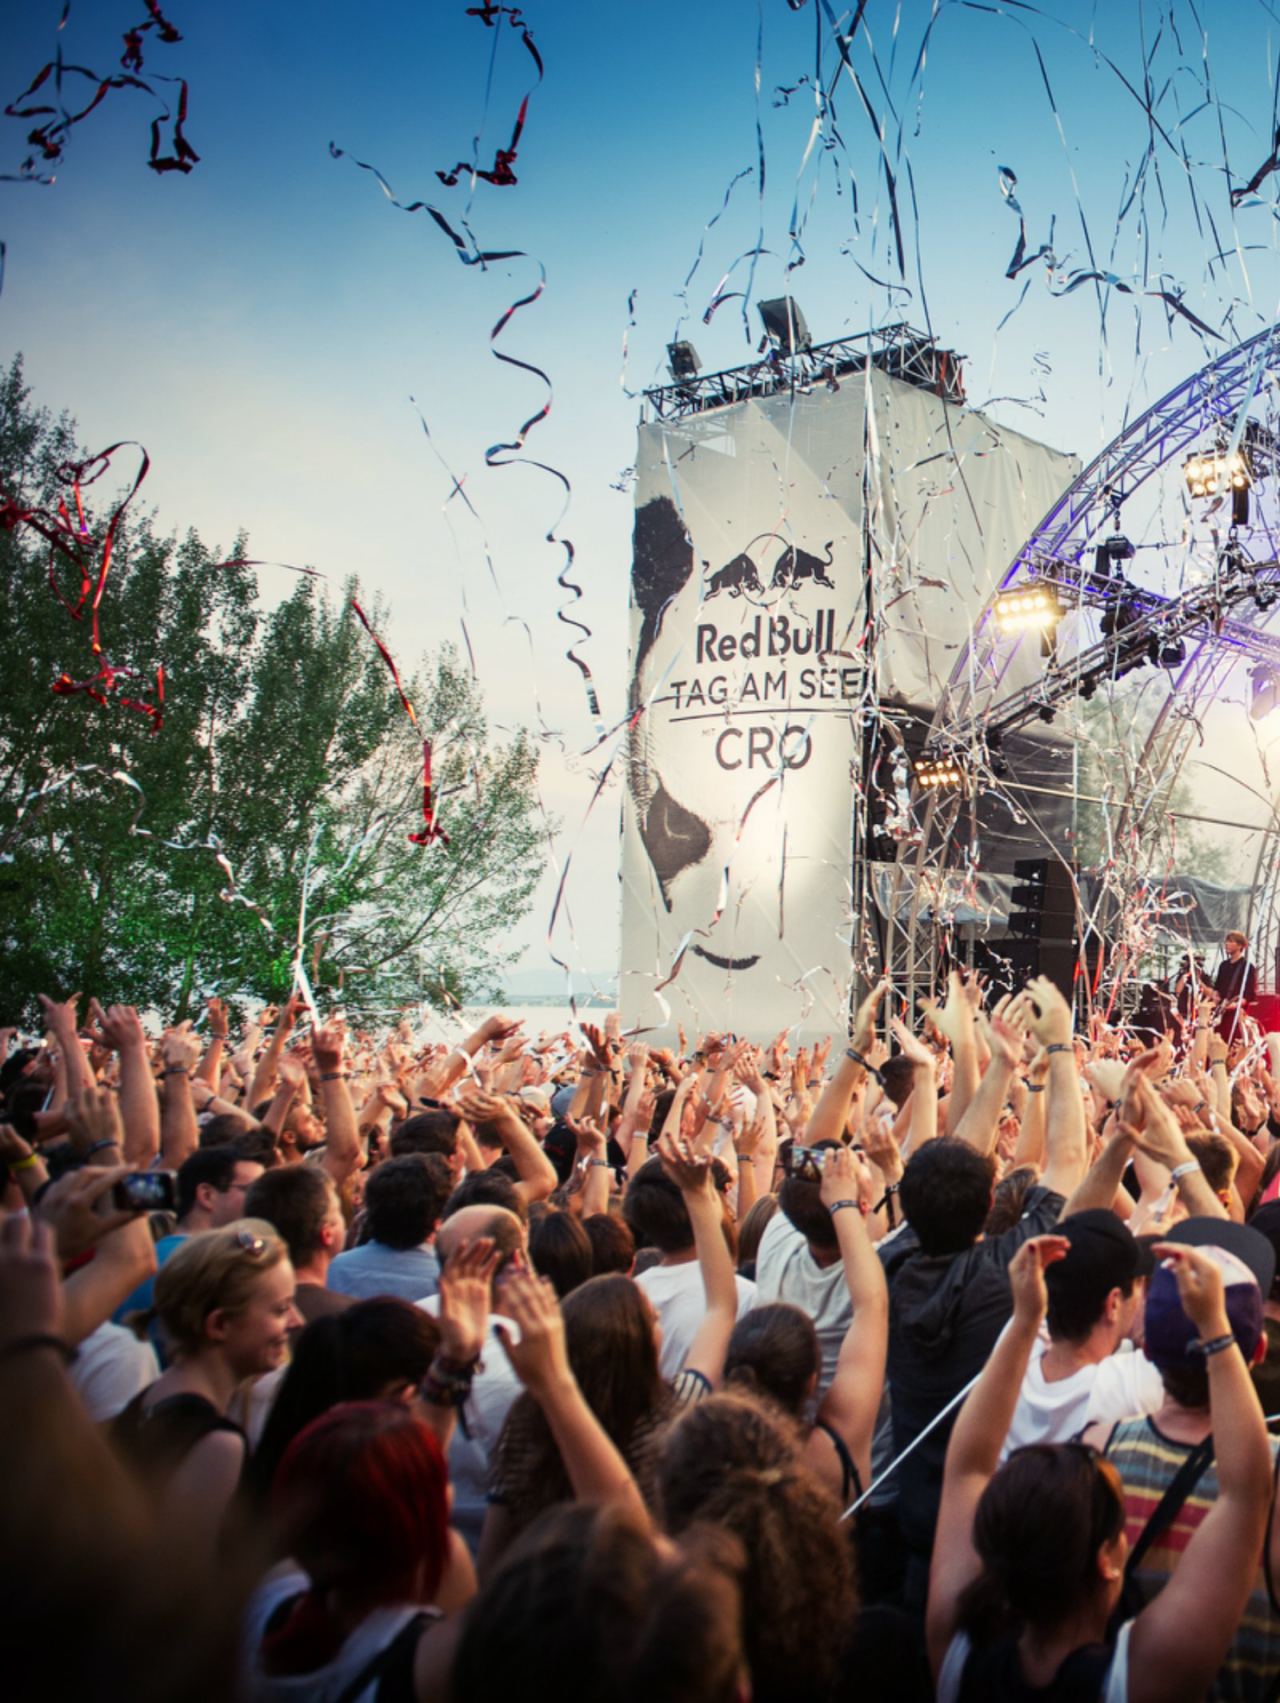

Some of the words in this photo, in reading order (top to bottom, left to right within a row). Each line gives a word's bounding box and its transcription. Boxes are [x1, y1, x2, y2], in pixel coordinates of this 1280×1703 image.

[696, 614, 762, 664] Red
[767, 609, 835, 657] Bull
[670, 675, 728, 710] TAG
[741, 670, 787, 702] AM
[798, 667, 864, 700] SEE
[715, 724, 813, 771] CRO
